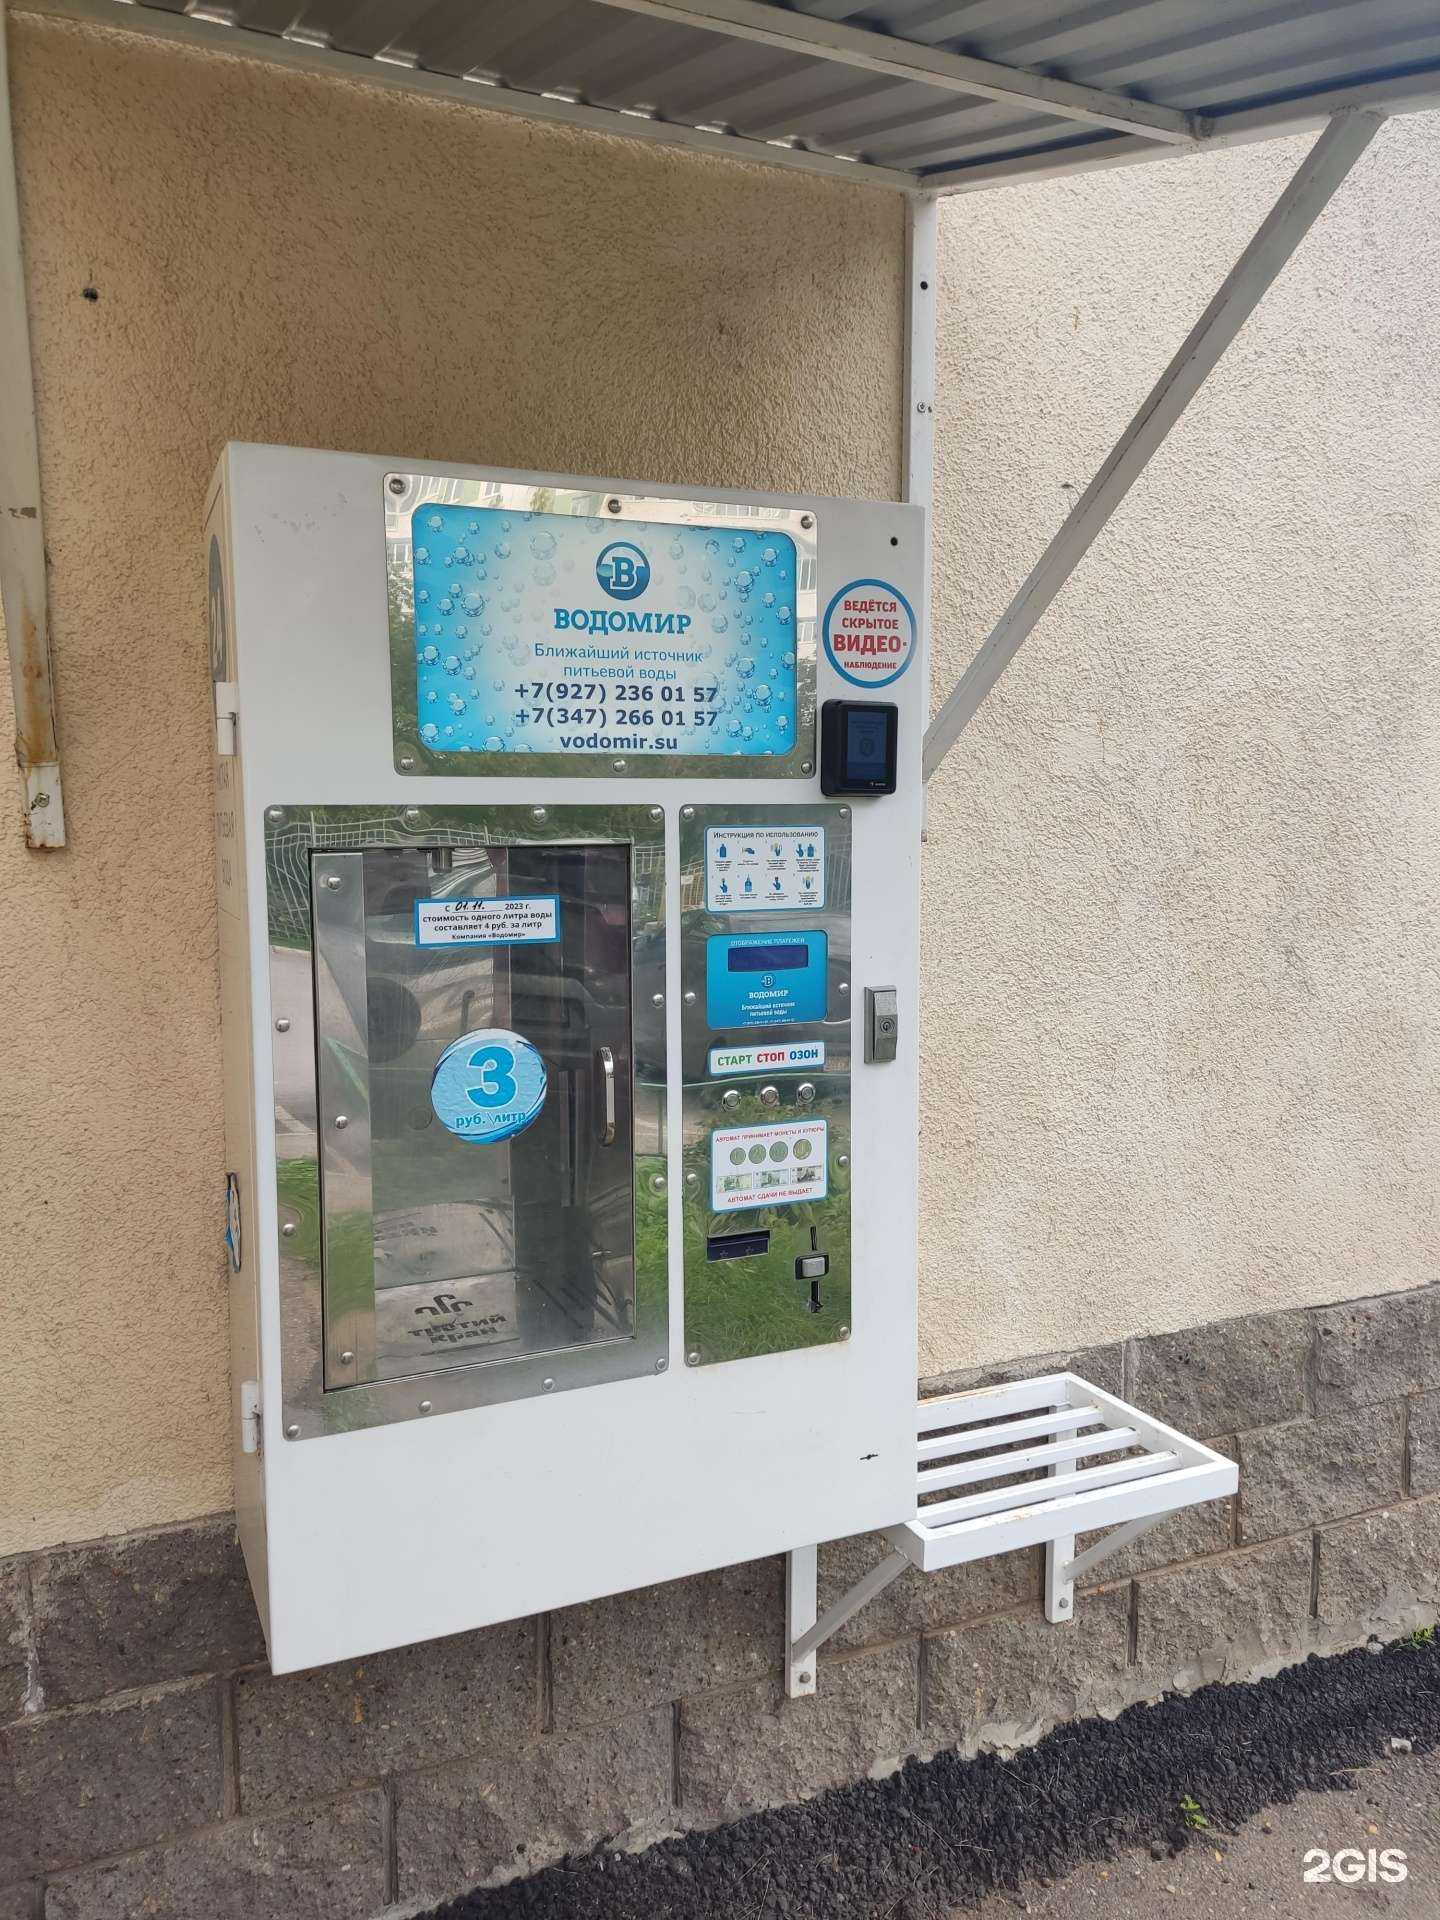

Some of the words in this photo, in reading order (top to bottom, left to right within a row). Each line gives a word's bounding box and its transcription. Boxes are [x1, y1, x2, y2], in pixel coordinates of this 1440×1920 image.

[843, 599, 897, 614] ВЕДЁТСЯ
[553, 608, 692, 635] ВОДОМИР
[841, 617, 899, 630] СКРЫТОЕ
[535, 643, 630, 661] Ближайший
[634, 650, 704, 663] источник
[843, 660, 897, 670] НАБЛЮДЕНИЕ
[563, 666, 634, 679] питьевой
[639, 669, 677, 682] воды
[514, 682, 607, 704] +7(927)
[615, 684, 654, 701] 236
[660, 686, 686, 703] 01
[693, 687, 718, 703] 57
[515, 707, 607, 728] +7(347)
[615, 709, 654, 726] 266
[661, 710, 686, 726] 01
[693, 711, 718, 727] 57
[559, 733, 678, 750] vodomir.su
[765, 831, 819, 839] ИСПОЛЬЗОВАНИЮ
[505, 903, 523, 911] 2023
[422, 915, 469, 923] стоимость
[471, 913, 501, 922] одного
[503, 912, 528, 921] литра
[530, 911, 553, 919] воды
[434, 924, 482, 932] составляет
[484, 922, 490, 930] 4
[491, 922, 508, 931] руб.
[521, 921, 542, 930] литр
[748, 989, 789, 999] ВОДОМИР
[717, 1054, 753, 1067] СТАРТ
[756, 1051, 785, 1063] СТОП
[789, 1049, 819, 1061] ОЗОН
[465, 1044, 519, 1109] 3
[455, 1113, 486, 1128] руб.
